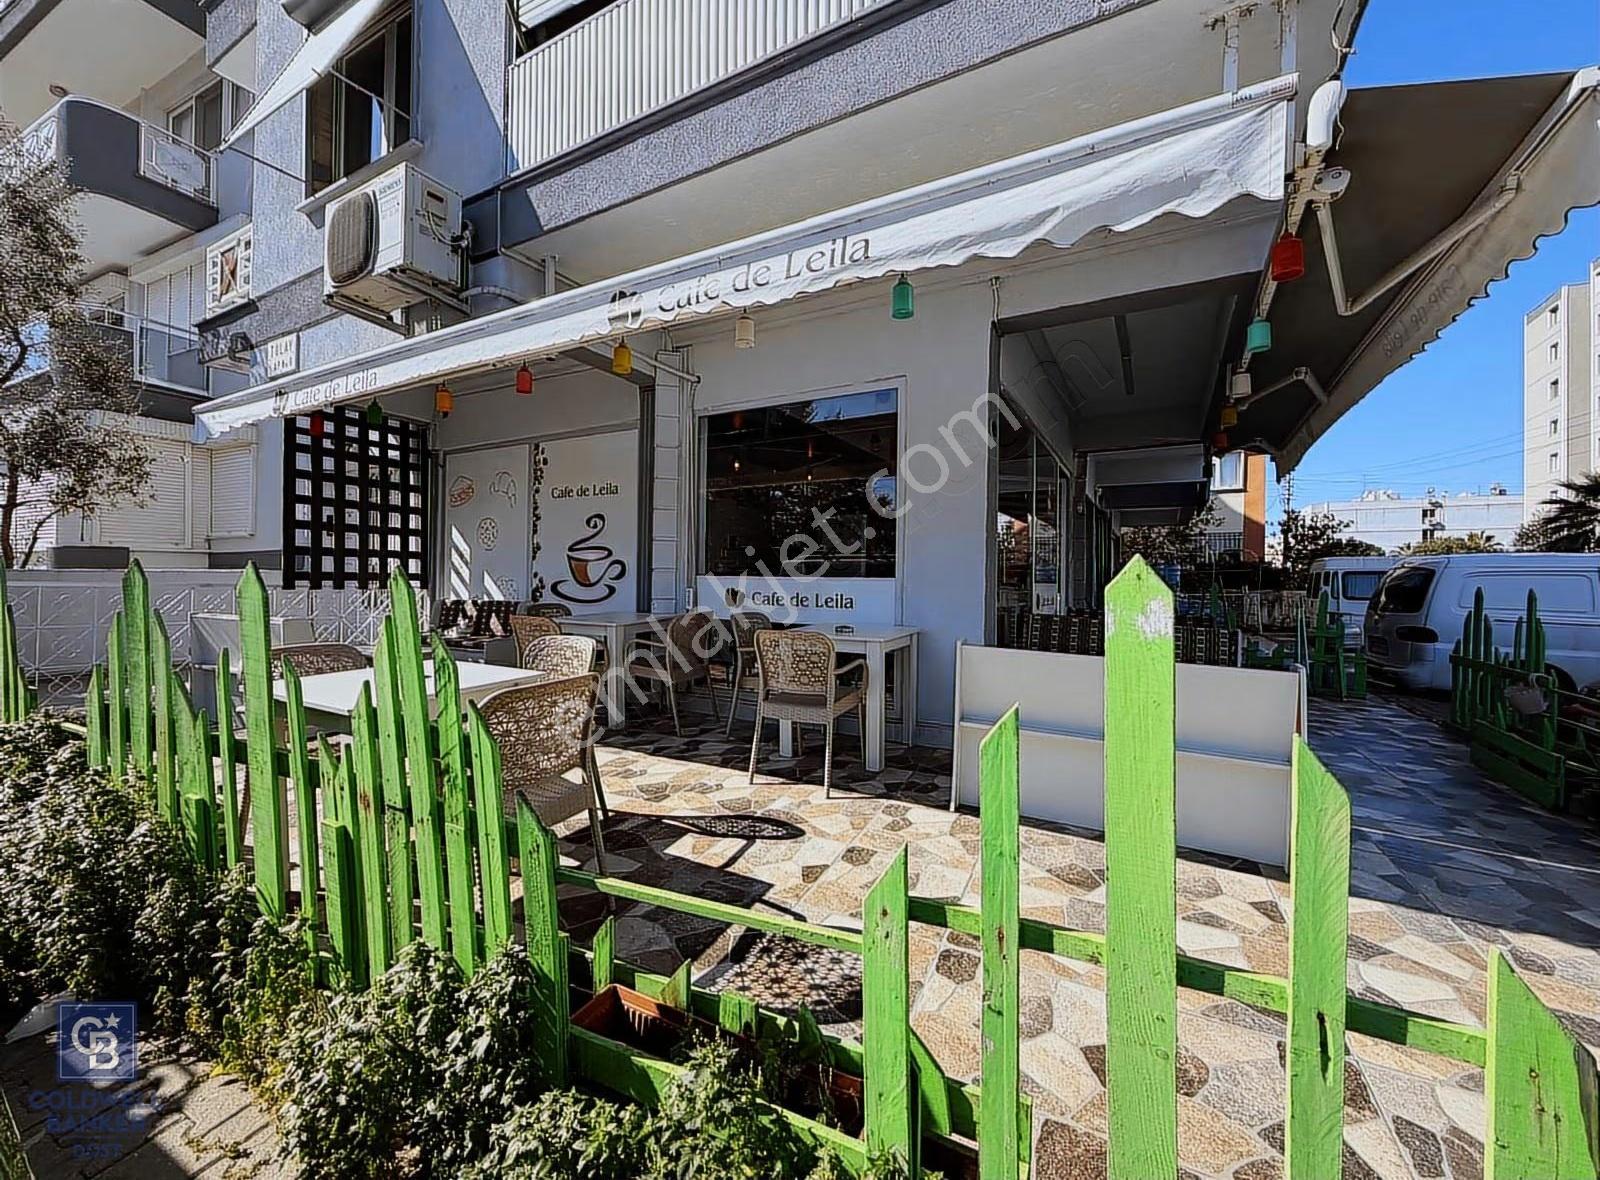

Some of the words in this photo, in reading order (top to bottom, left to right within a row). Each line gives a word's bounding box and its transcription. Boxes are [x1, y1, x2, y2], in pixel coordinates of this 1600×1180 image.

[657, 274, 721, 313] Cafe
[732, 262, 771, 293] de
[784, 236, 872, 280] Leila
[324, 380, 340, 399] de
[345, 368, 378, 394] Leila
[551, 486, 574, 499] Cafe
[576, 484, 590, 497] de
[593, 482, 619, 497] Leila
[751, 591, 785, 607] Cafe
[790, 592, 809, 608] de
[815, 592, 854, 609] Leila
